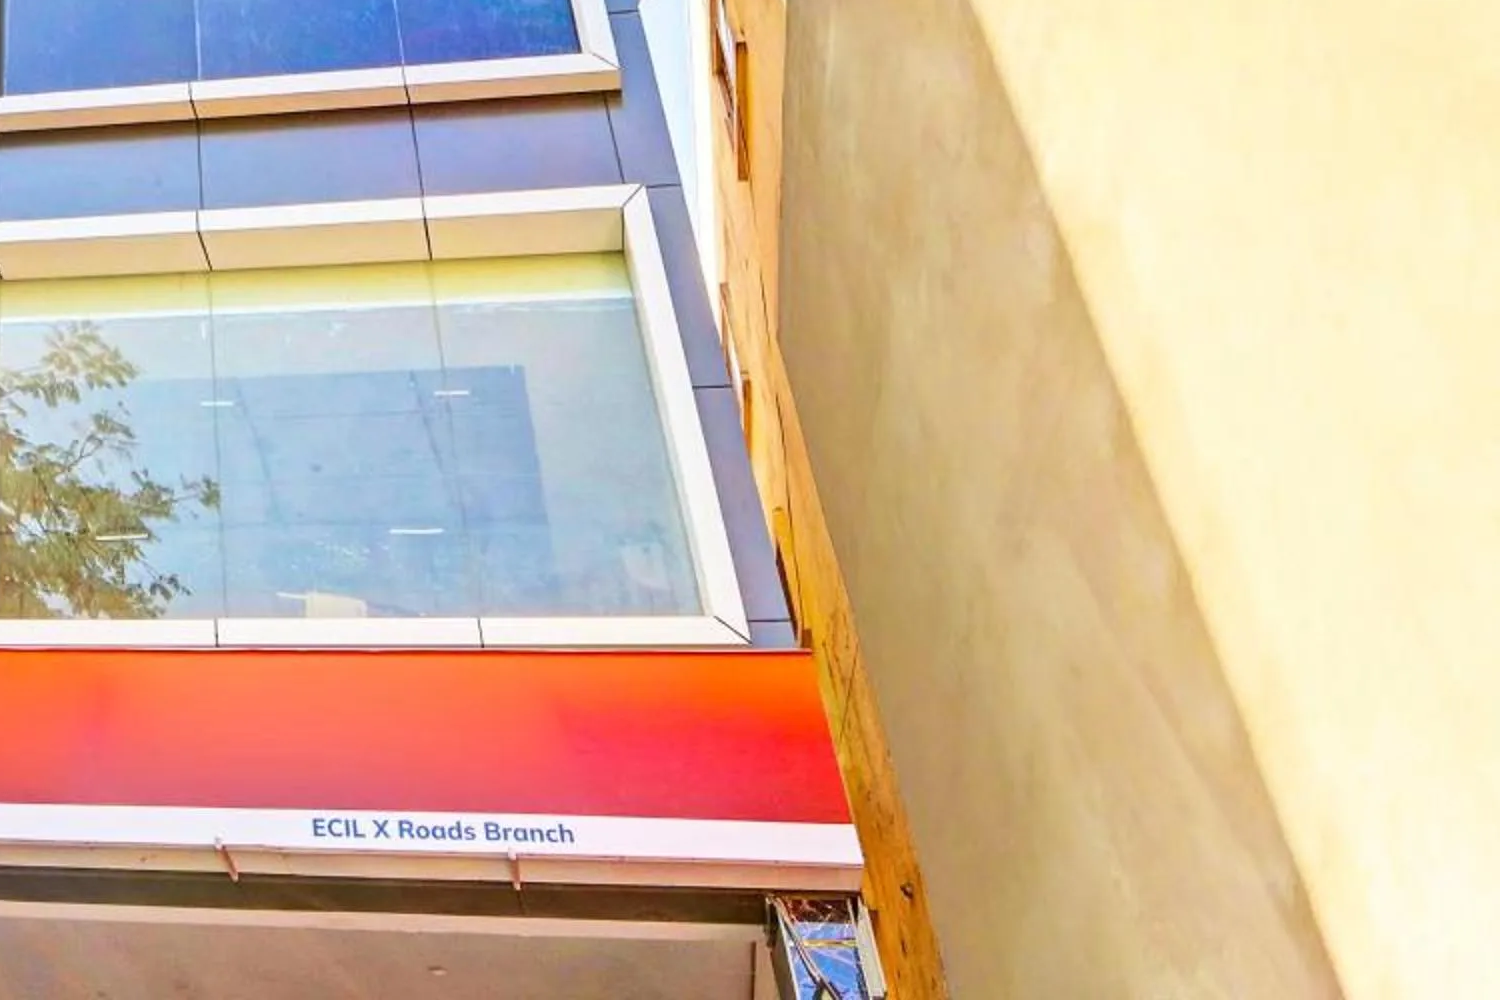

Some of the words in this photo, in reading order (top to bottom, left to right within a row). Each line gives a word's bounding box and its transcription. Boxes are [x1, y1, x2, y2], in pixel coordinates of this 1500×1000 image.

[312, 818, 366, 839] ECIL
[372, 819, 390, 839] X
[397, 820, 477, 842] Roads
[484, 822, 575, 844] Branch
